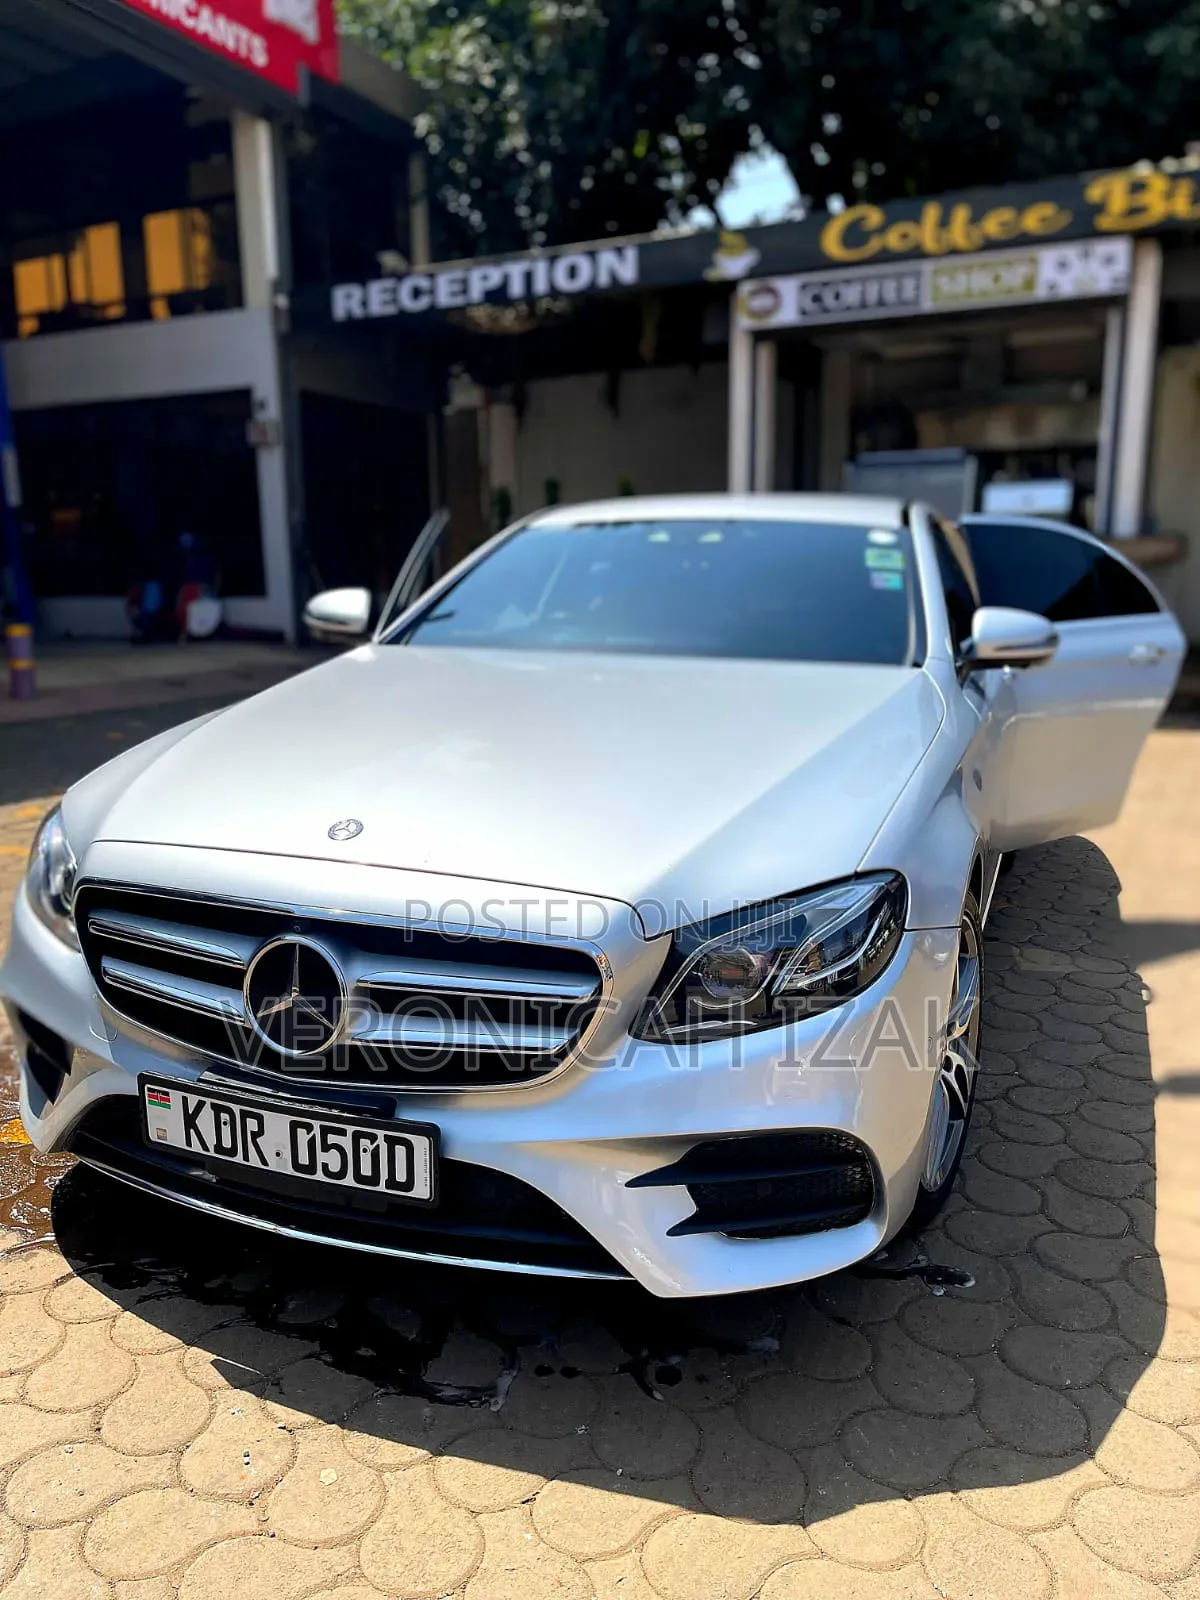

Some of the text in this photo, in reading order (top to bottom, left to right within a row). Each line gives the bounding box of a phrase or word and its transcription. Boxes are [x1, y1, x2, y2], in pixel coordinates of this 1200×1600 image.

[819, 202, 1072, 262] Coffee
[331, 246, 638, 322] RECEPTION
[181, 1095, 269, 1167] KDR
[289, 1119, 416, 1193] 050D
